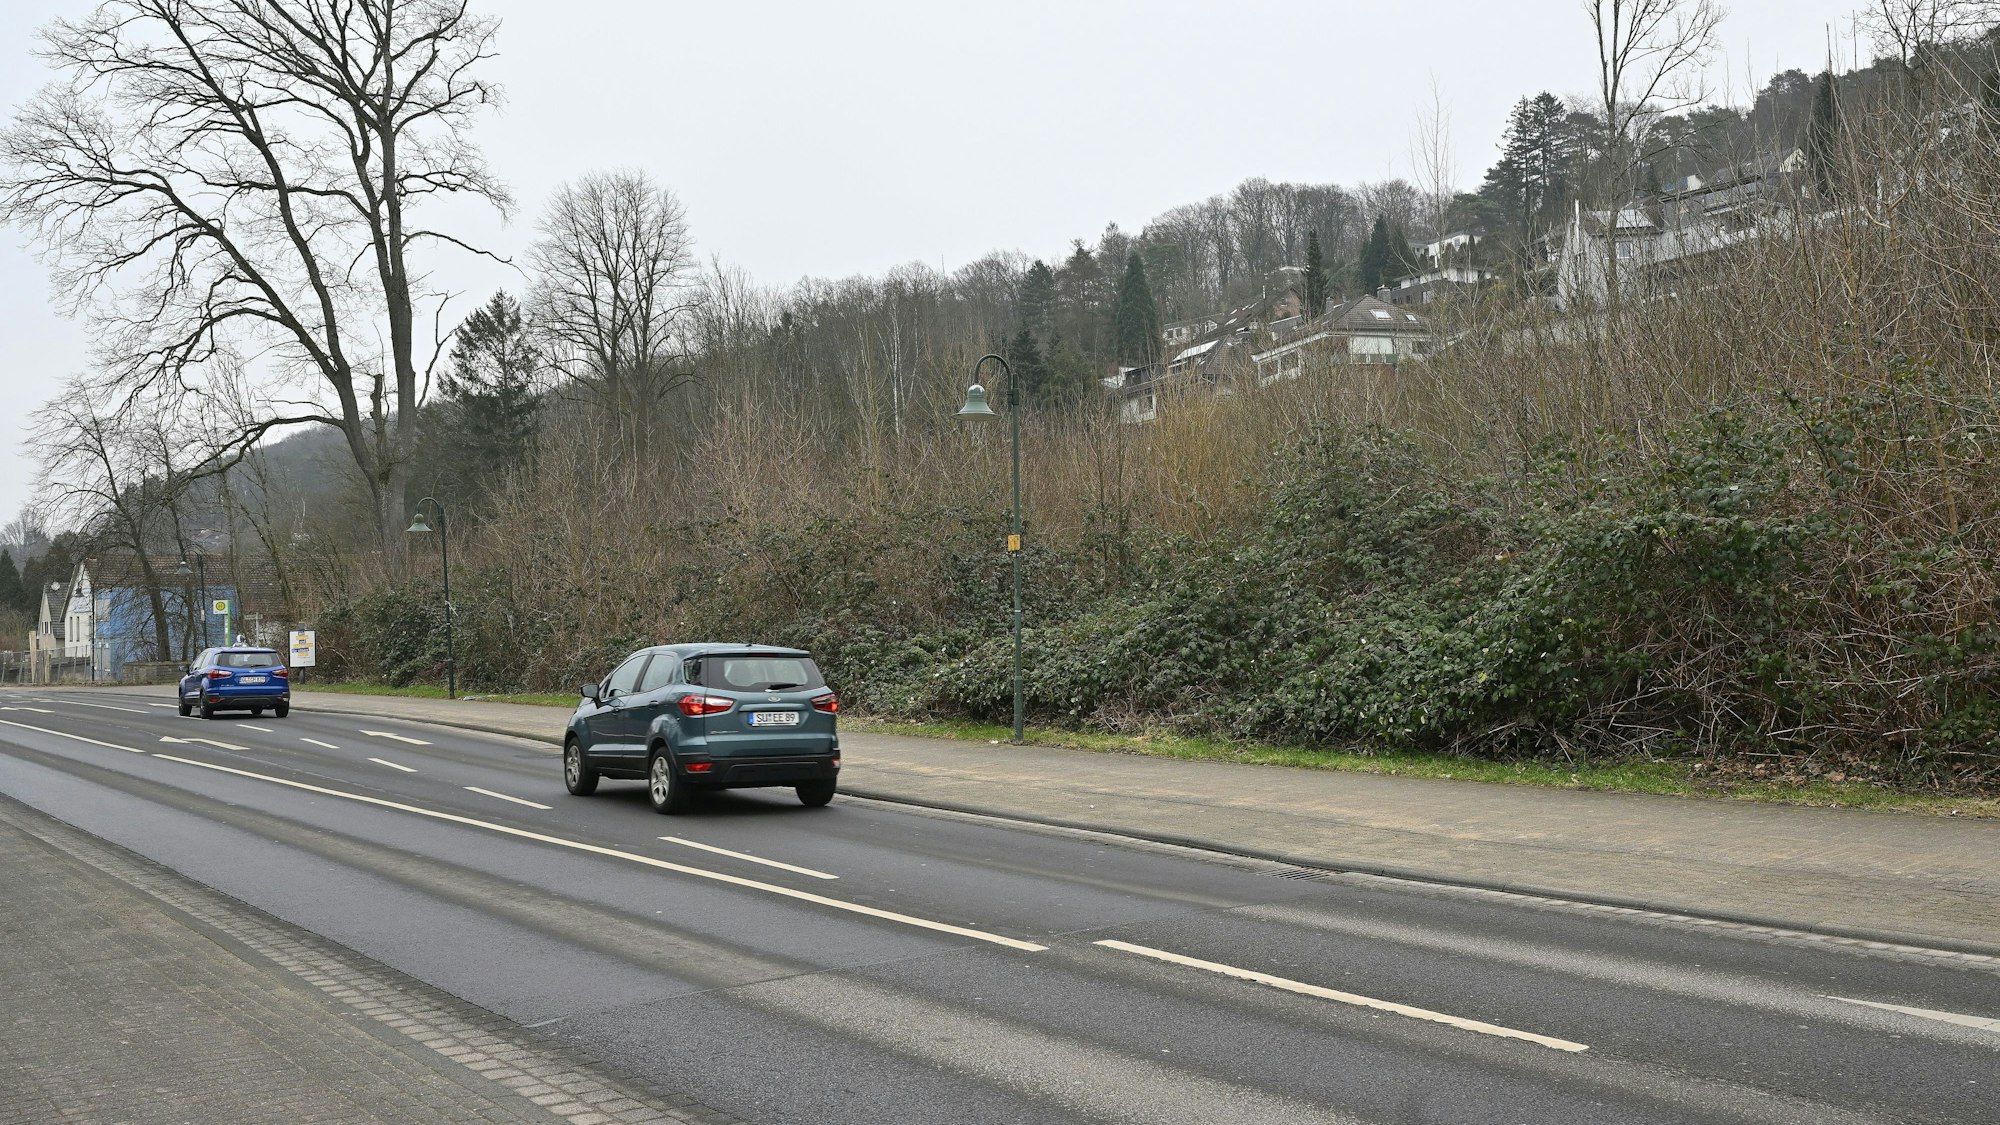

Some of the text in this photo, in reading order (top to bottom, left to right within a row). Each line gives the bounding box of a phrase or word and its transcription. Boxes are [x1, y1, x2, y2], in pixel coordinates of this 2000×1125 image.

[757, 713, 796, 722] SU EE 89
